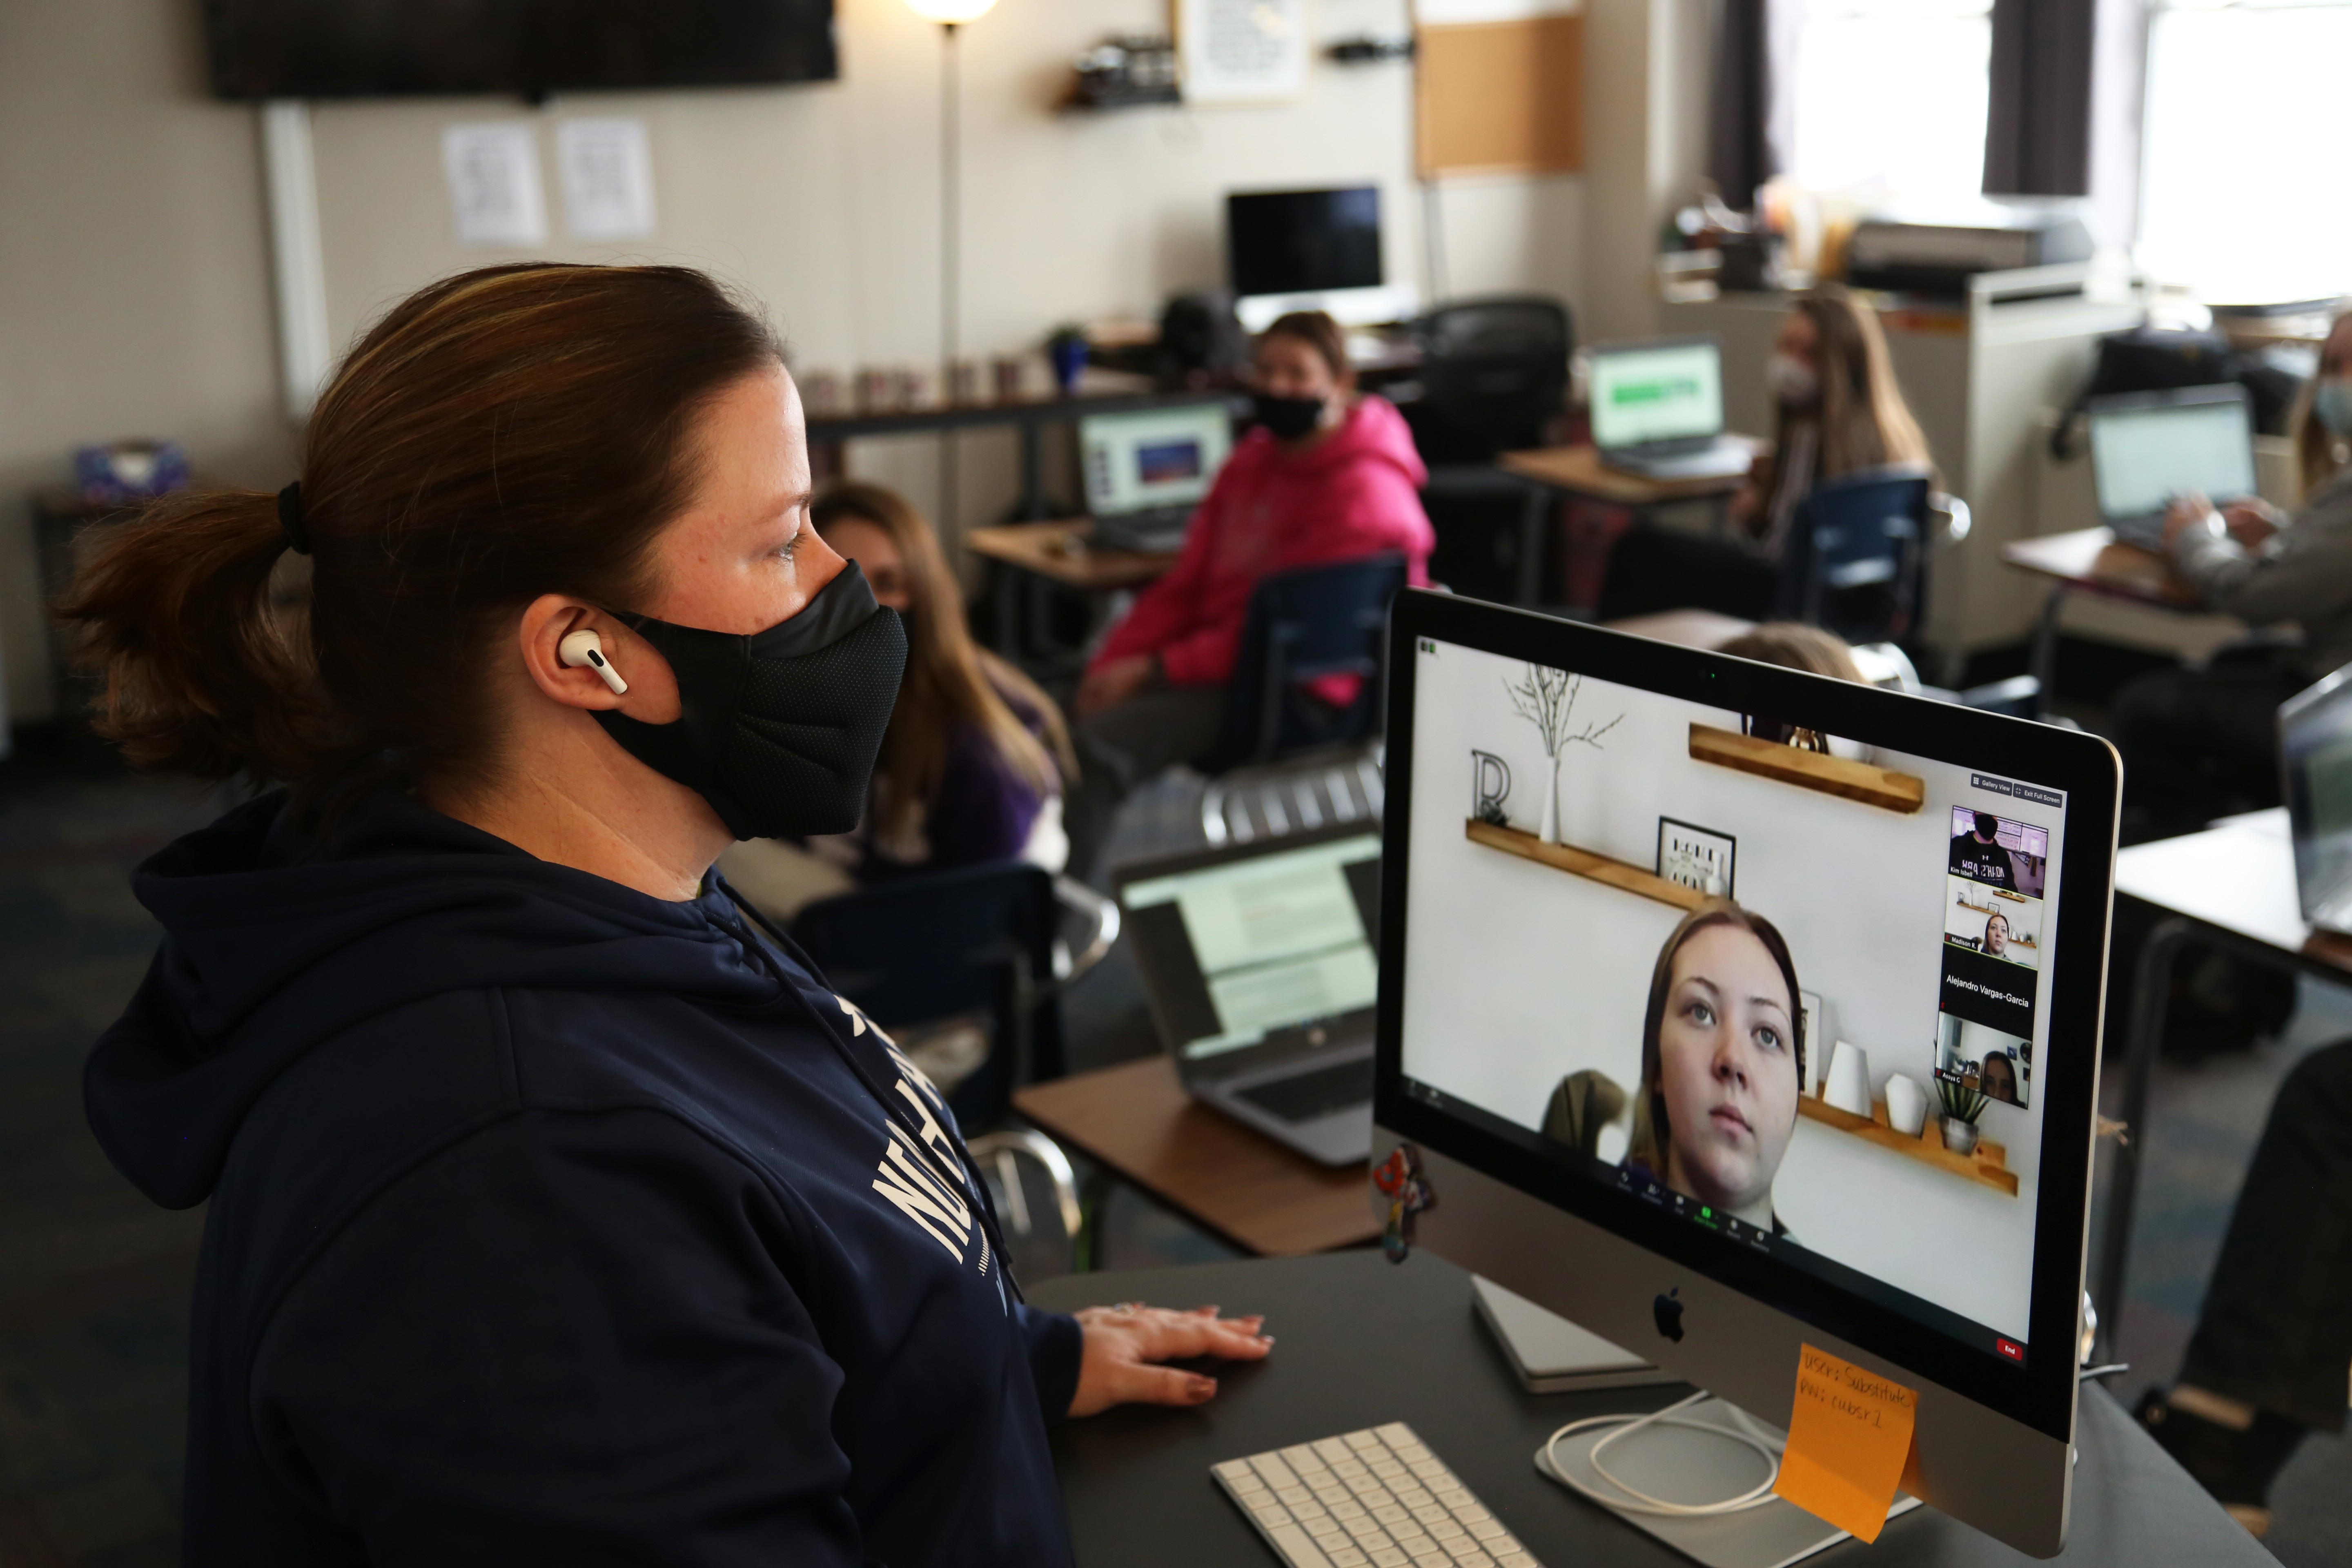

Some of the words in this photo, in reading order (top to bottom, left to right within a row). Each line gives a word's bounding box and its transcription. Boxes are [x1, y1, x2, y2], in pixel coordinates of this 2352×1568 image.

[1982, 780, 1998, 790] Gallery
[1998, 783, 2010, 792] View
[2043, 795, 2060, 804] Screen
[1951, 866, 1960, 874] Kim
[1952, 936, 1971, 947] Madison
[1947, 974, 1978, 992] Alejandro
[1980, 984, 2029, 1008] Vargas-Garcia
[2005, 1345, 2016, 1354] End
